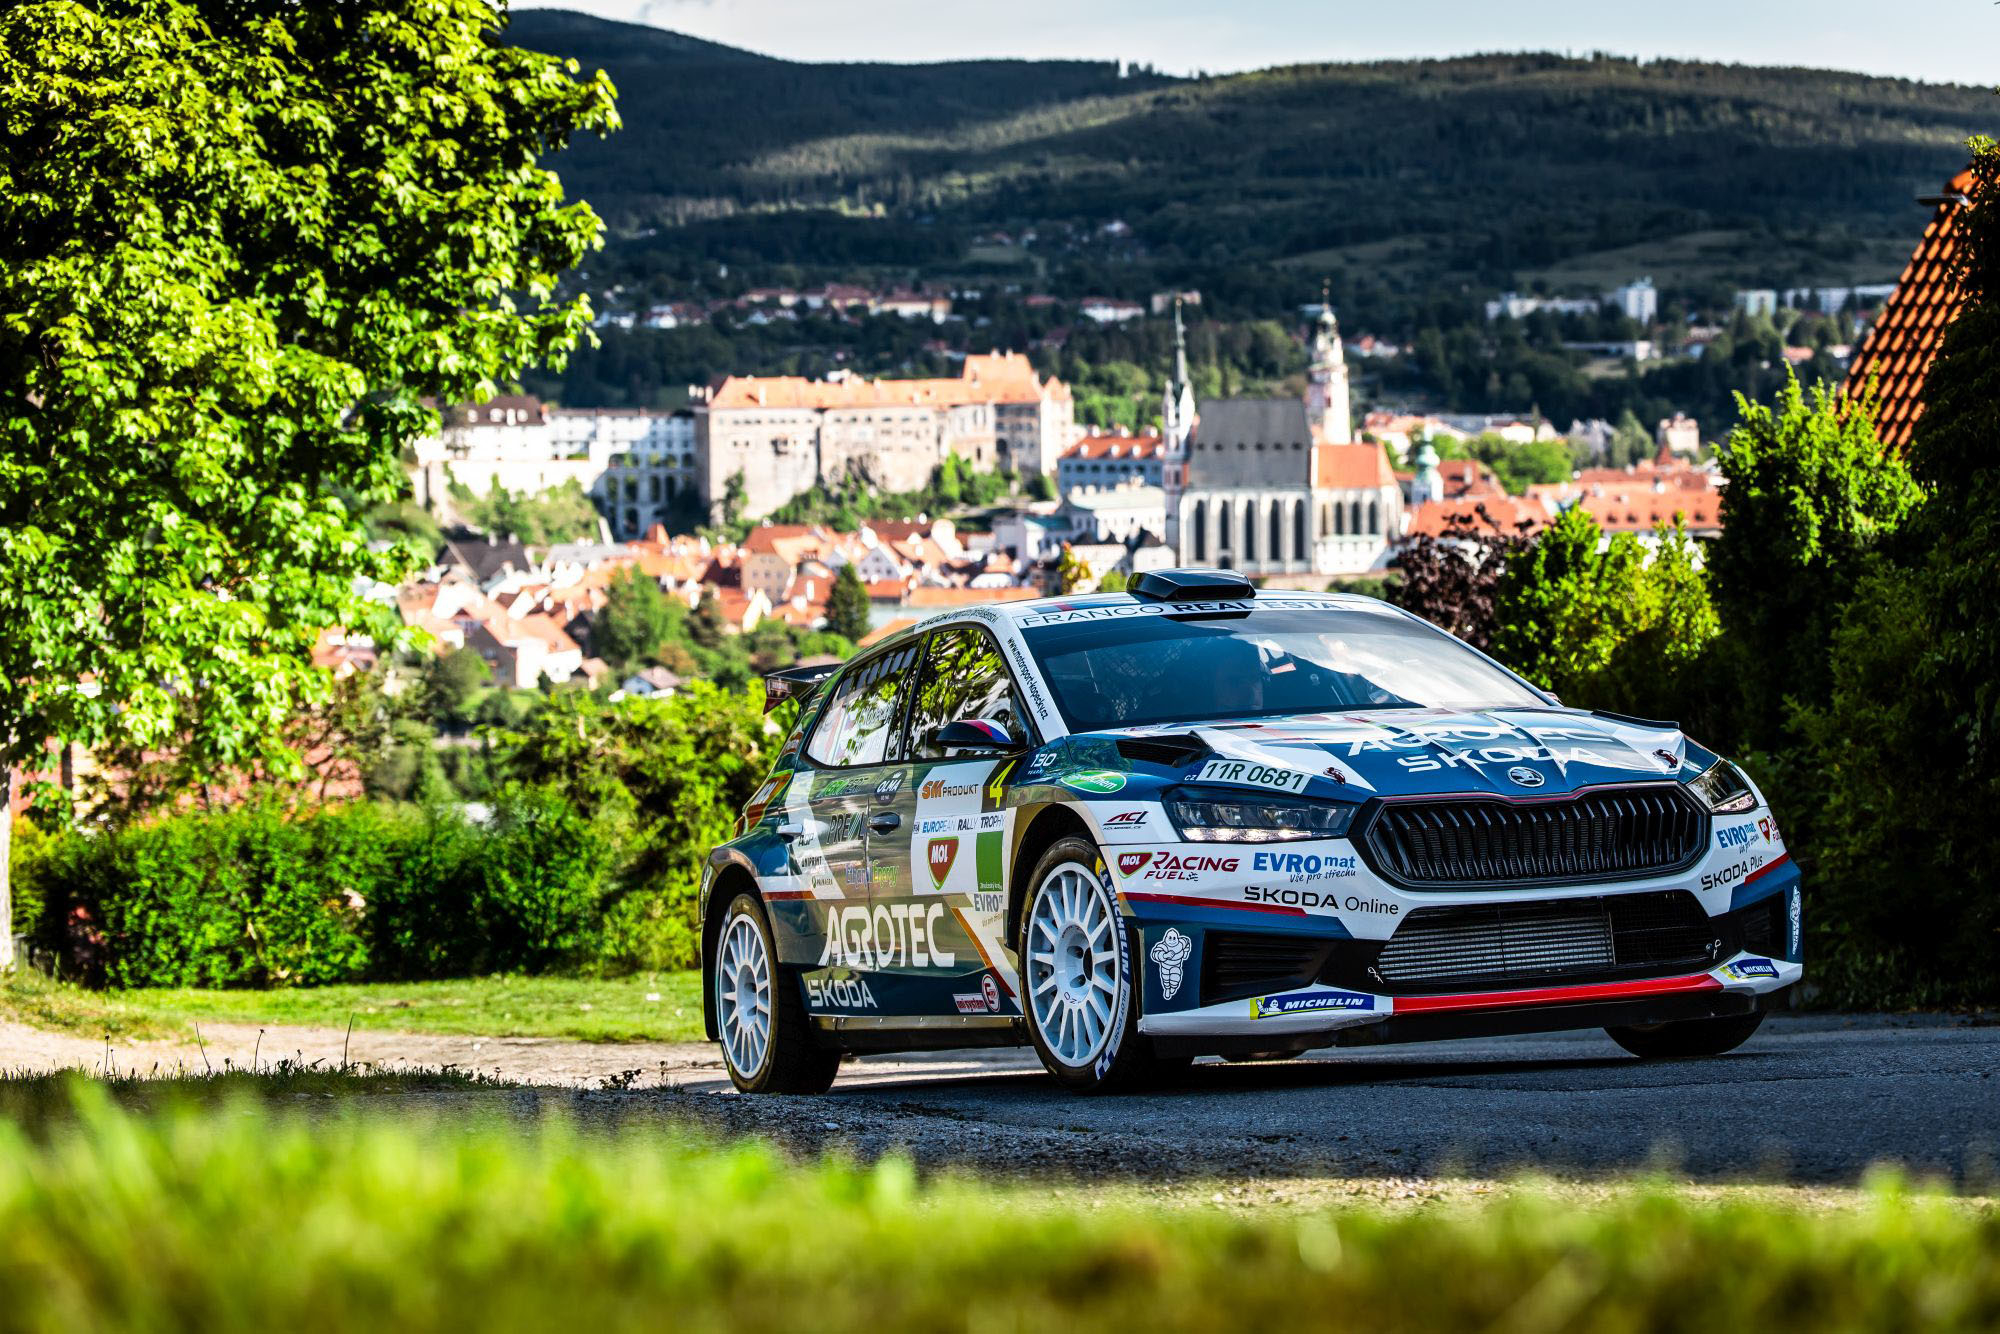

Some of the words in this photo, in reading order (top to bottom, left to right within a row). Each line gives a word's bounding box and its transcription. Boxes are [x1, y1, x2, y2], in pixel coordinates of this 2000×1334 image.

[1022, 605, 1164, 627] FRANCO
[1171, 602, 1256, 613] REAL
[1260, 601, 1353, 611] ESTA
[1030, 752, 1058, 768] 130
[989, 759, 1017, 809] 4
[1205, 762, 1246, 781] 11R
[1246, 765, 1305, 790] 0681
[876, 779, 901, 794] OLMA
[942, 783, 979, 798] PRODUKT
[957, 817, 979, 832] RALLY
[980, 814, 1006, 830] TROPHY
[1107, 810, 1150, 825] ACL
[1716, 825, 1748, 849] EVRO
[930, 844, 949, 865] MOL
[1120, 855, 1141, 867] MOL
[1152, 851, 1241, 873] RACING
[1253, 852, 1322, 874] EVRO
[1324, 855, 1356, 869] mat
[1750, 855, 1763, 872] Plus
[1143, 870, 1186, 882] FUEL
[1289, 873, 1304, 884] Vše
[1306, 872, 1323, 885] pro
[1324, 866, 1357, 880] střechu
[1345, 896, 1400, 915] Online
[818, 903, 955, 969] AGROTEC
[1106, 883, 1130, 975] MICHELIN
[1284, 998, 1365, 1010] MICHELIN
